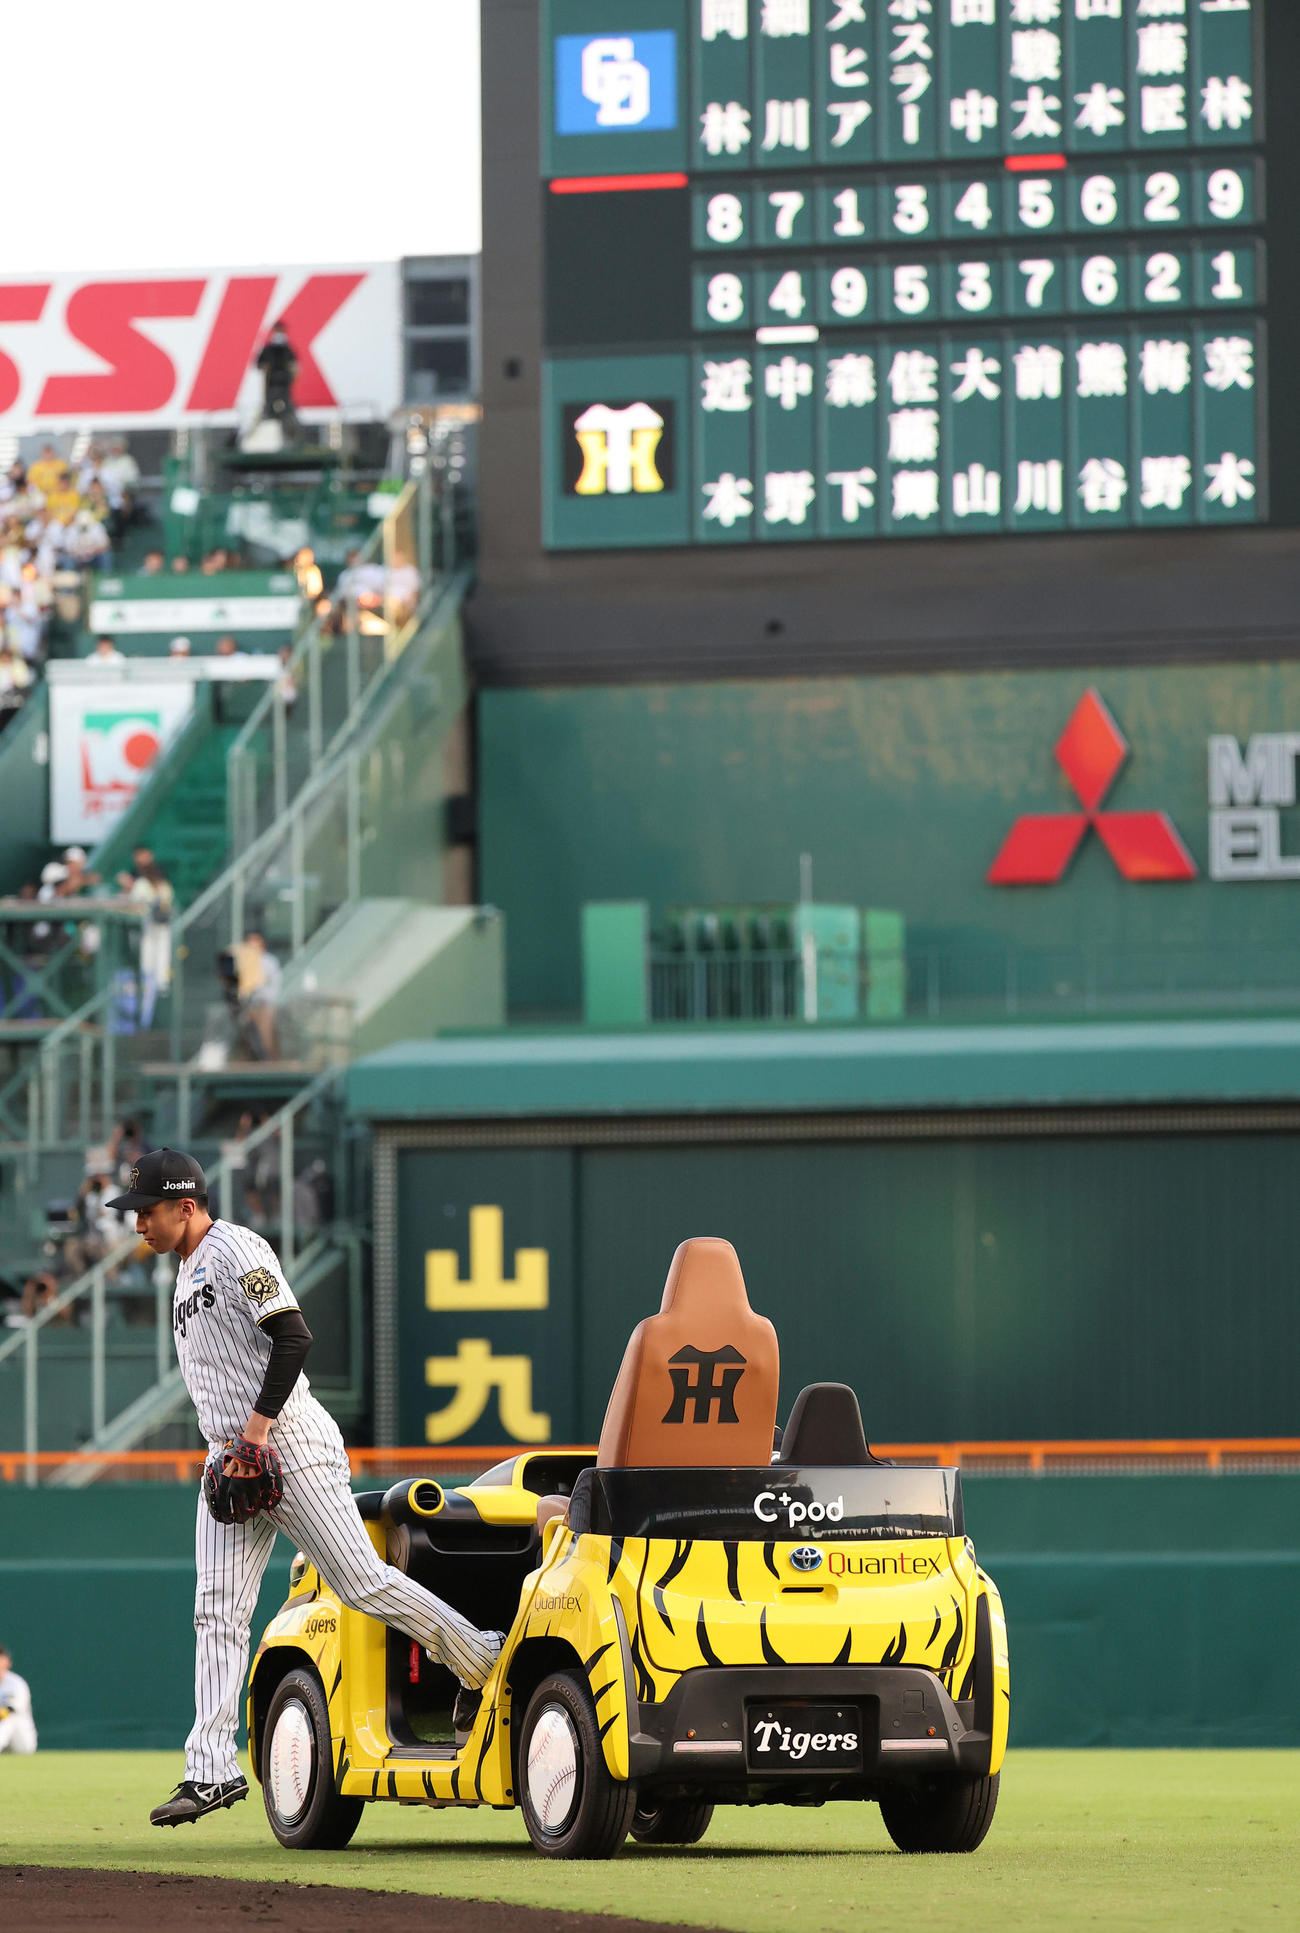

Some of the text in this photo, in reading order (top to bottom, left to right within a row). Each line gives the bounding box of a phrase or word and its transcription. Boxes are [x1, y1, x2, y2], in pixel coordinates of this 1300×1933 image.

[1200, 0, 1251, 129] 林
[707, 170, 1243, 242] 8 7 1 3 4 5 6 2 9
[708, 252, 1241, 321] 8 4 9 5 3 7 6 2 1
[702, 359, 752, 526] 近本
[764, 357, 814, 523] 中野
[951, 349, 999, 516] 大山
[1013, 346, 1062, 512] 前川
[1208, 732, 1300, 808] MI
[163, 1180, 196, 1190] Joshin
[175, 1284, 215, 1338] igers
[425, 1204, 550, 1444] 山九
[535, 1592, 582, 1615] Quantex
[828, 1552, 943, 1581] Quantex
[753, 1720, 858, 1760] Tigers
